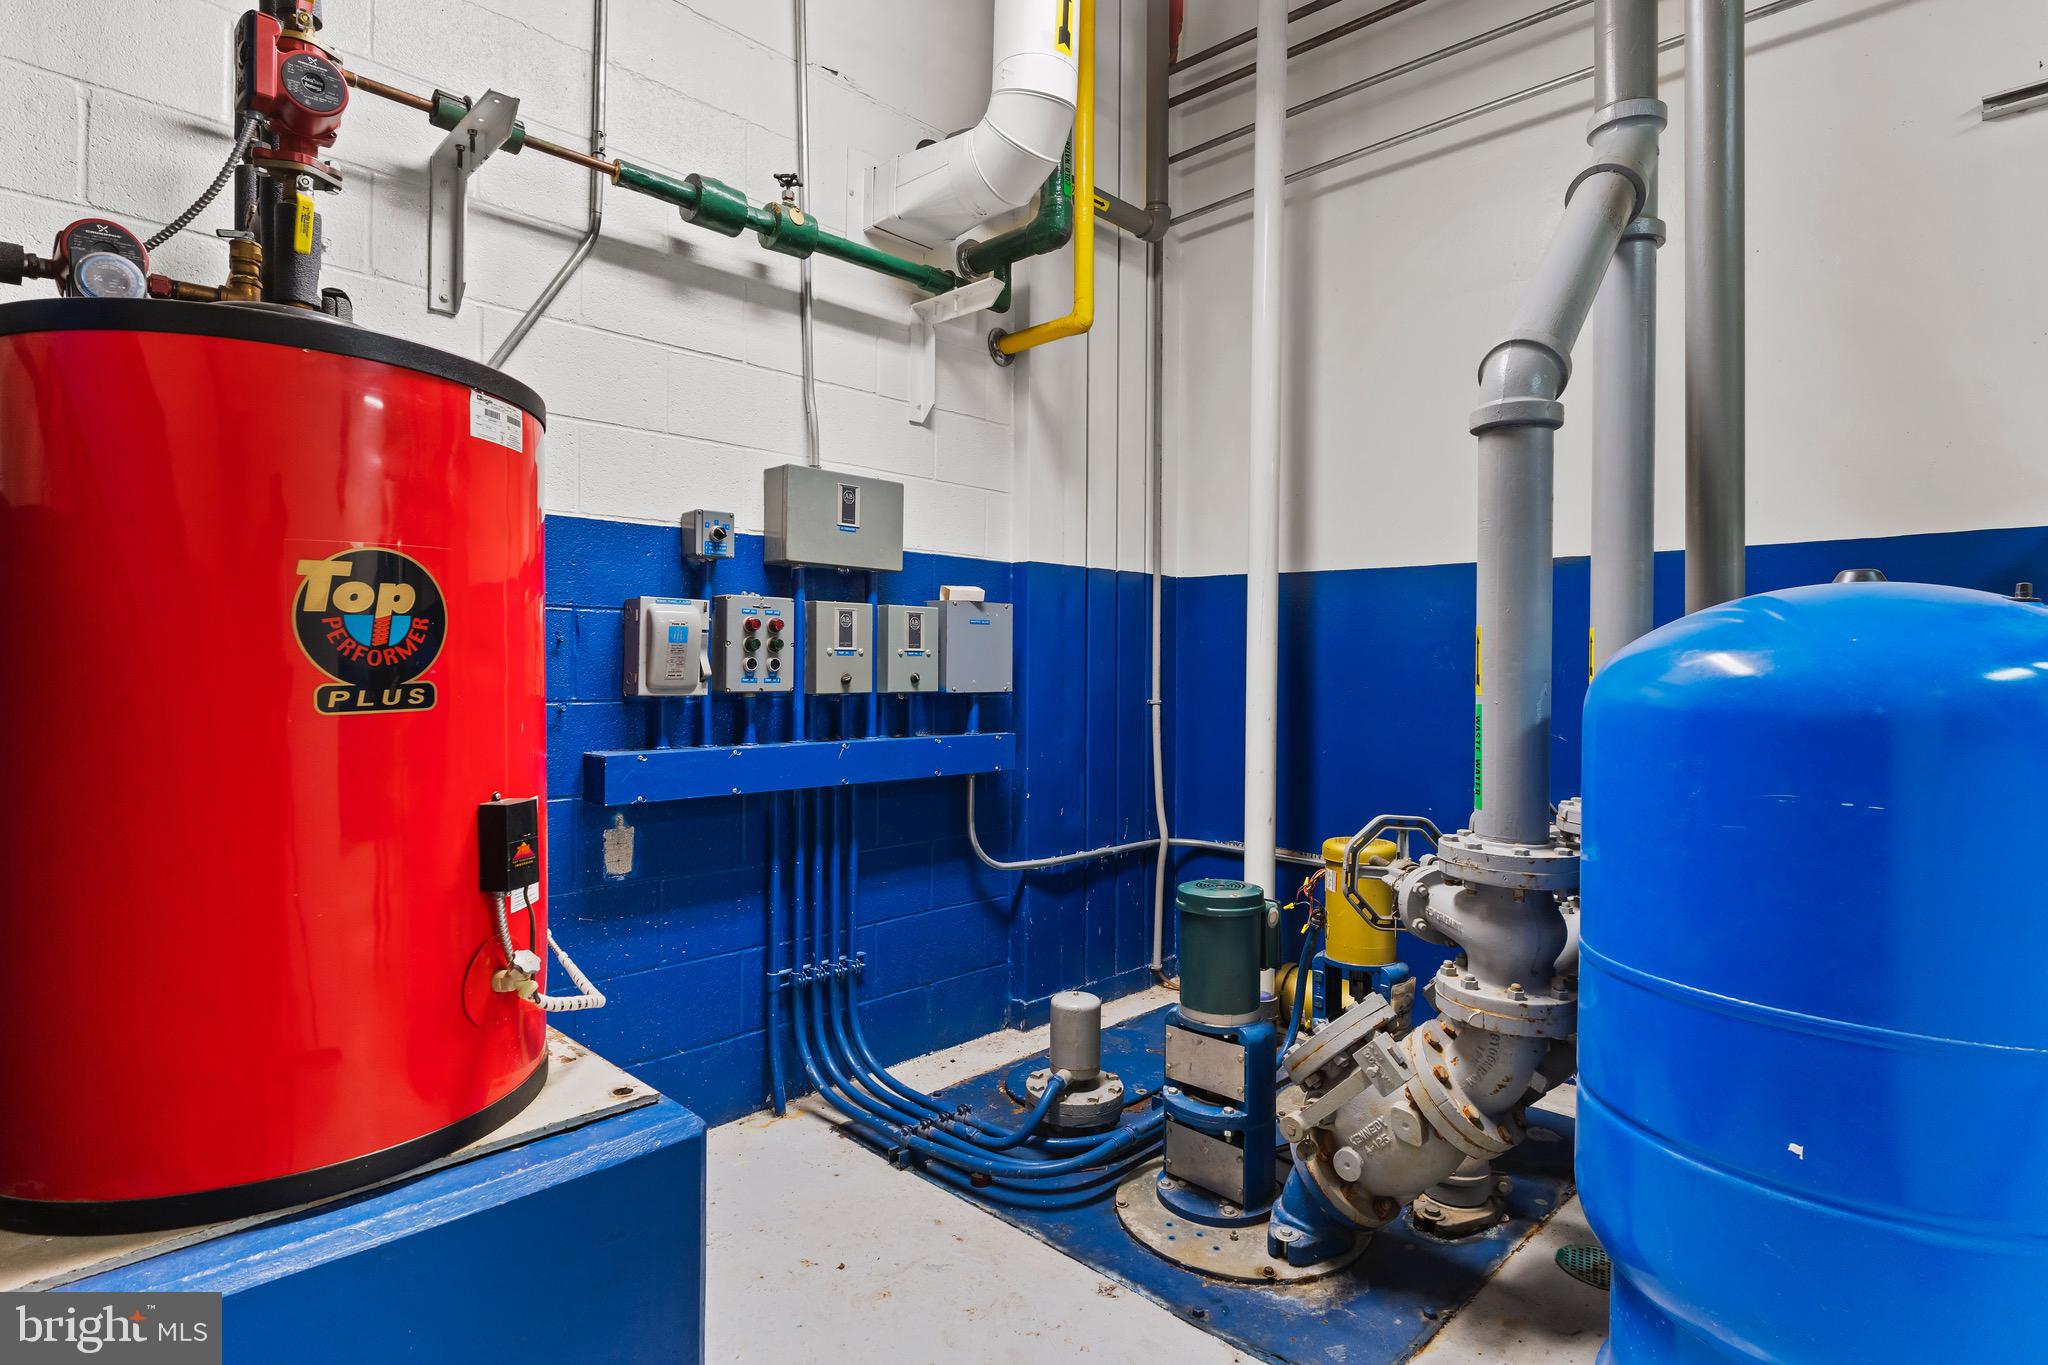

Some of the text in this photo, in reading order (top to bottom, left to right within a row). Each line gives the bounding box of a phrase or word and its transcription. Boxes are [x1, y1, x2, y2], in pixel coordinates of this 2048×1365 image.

[296, 559, 416, 620] Top
[321, 616, 430, 667] PERFORMER
[327, 687, 425, 708] PLUS
[1349, 1115, 1388, 1146] KENNEDY
